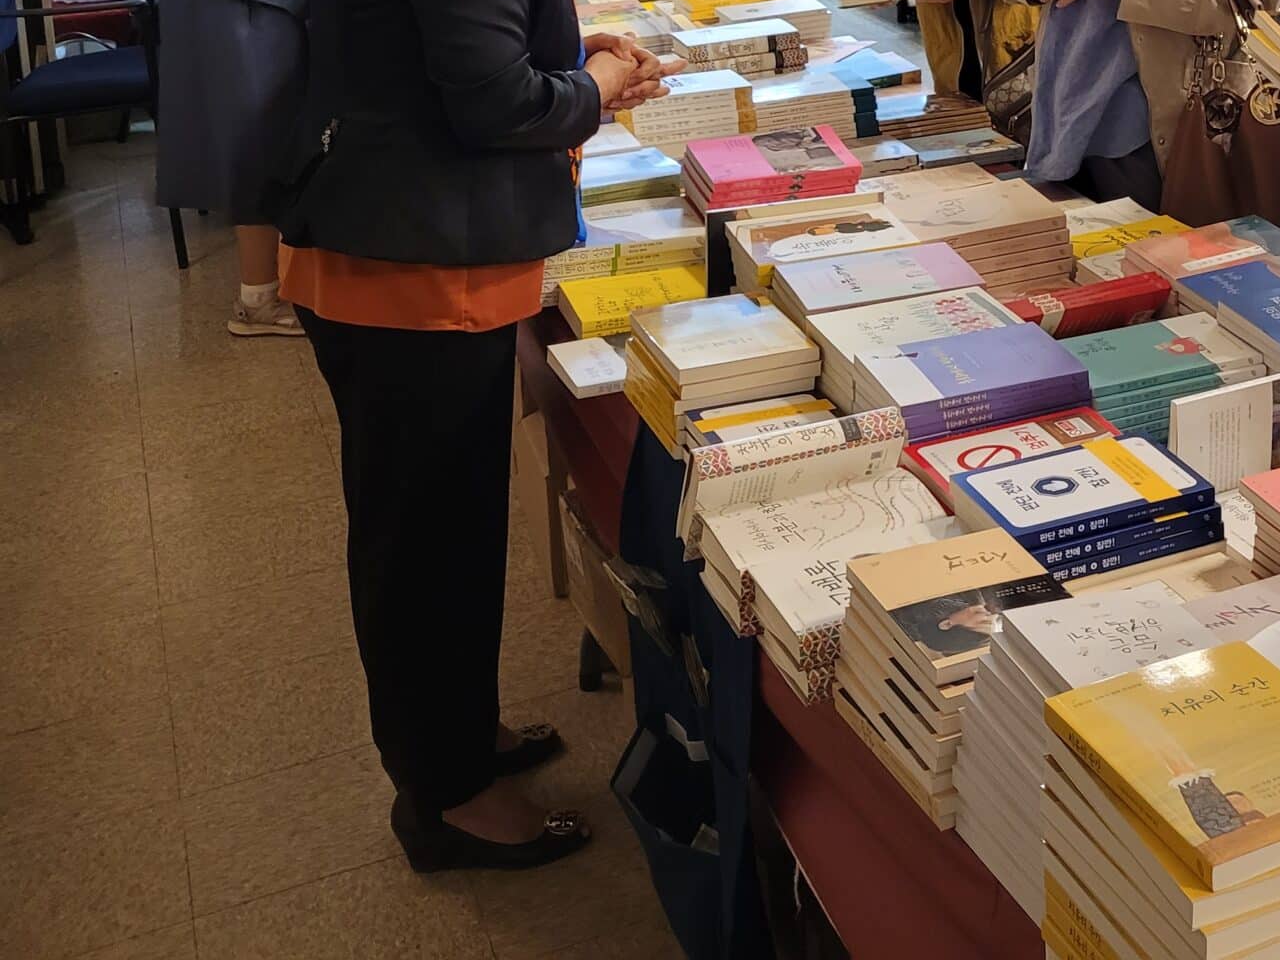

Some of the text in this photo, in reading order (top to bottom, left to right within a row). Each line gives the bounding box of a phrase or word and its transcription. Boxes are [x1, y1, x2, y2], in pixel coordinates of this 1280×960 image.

[1073, 464, 1111, 489] 잠깐!
[1014, 491, 1041, 512] 판단
[1039, 516, 1109, 543] 판단 전에 잠깐!
[1046, 537, 1116, 563] 판단 전에 잠깐!
[1052, 555, 1121, 581] 판단 전에 잠깐!
[1160, 689, 1226, 718] 치유의
[1229, 676, 1271, 697] 순간
